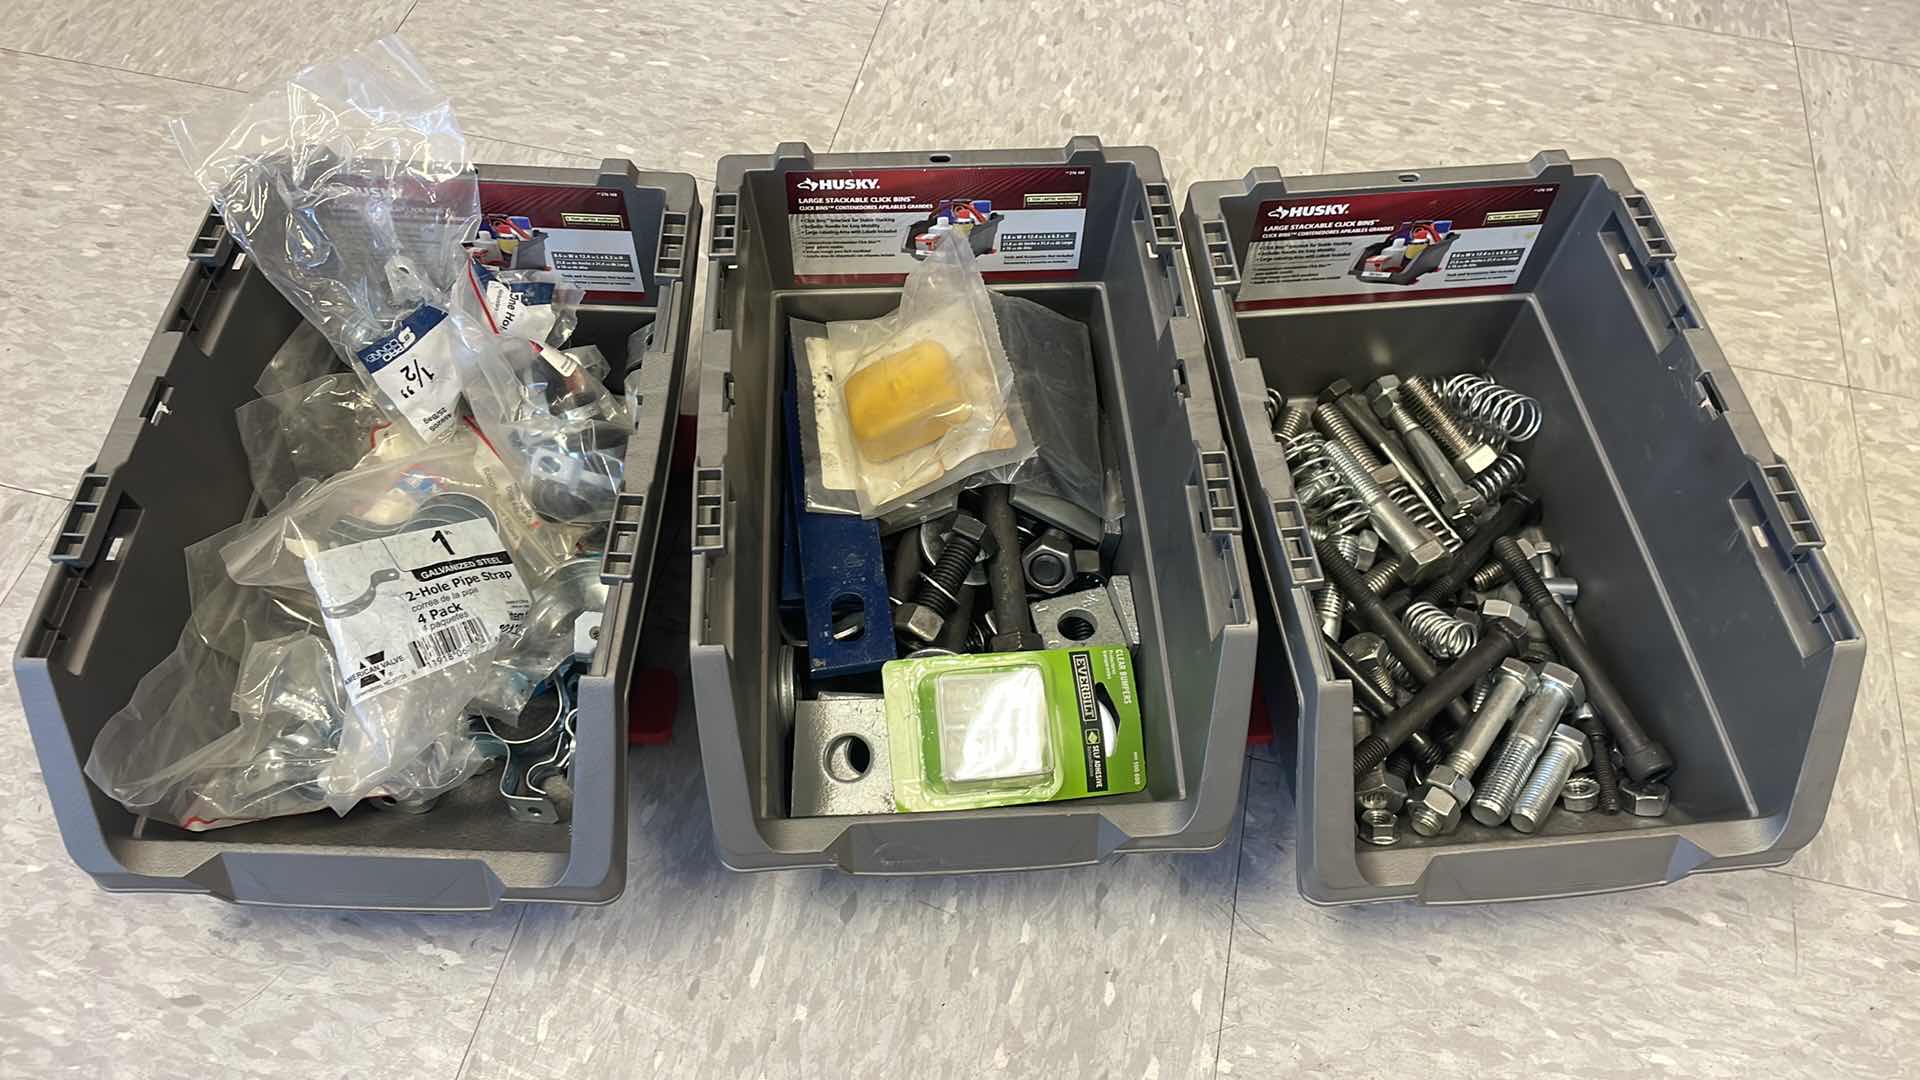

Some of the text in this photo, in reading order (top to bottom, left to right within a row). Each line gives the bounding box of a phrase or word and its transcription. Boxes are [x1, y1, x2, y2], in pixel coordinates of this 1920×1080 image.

[825, 196, 869, 204] STACKABLE
[1263, 224, 1288, 232] LARGE
[1290, 222, 1333, 231] STACKABLE
[1334, 220, 1356, 228] CLICK
[432, 530, 456, 555] 1
[420, 556, 503, 579] GALVANIZED STEEL
[405, 570, 513, 602] 2-Hole Pipe Strap
[417, 602, 464, 624] 4 Pack
[382, 655, 404, 669] VALVE
[1115, 649, 1127, 670] CLEAR
[1075, 655, 1095, 720] EVERBILT
[1092, 744, 1103, 789] SELF ADHESIVE
